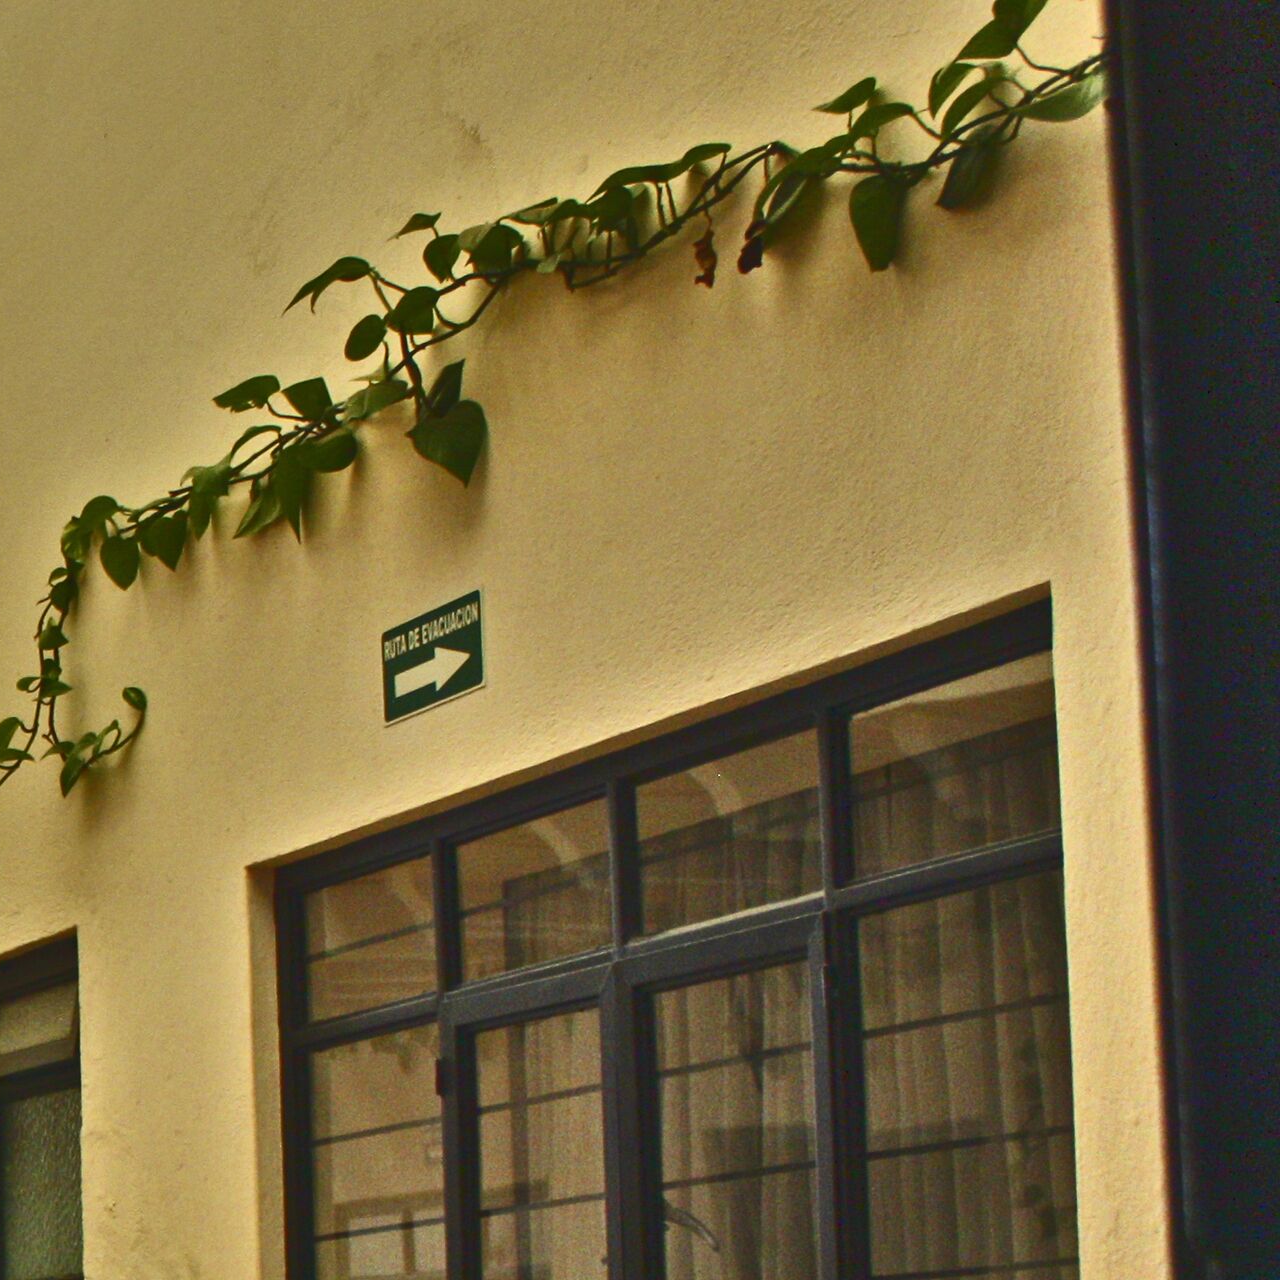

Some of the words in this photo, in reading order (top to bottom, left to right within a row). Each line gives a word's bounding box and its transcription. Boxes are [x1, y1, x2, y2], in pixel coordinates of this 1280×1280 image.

[384, 635, 407, 662] RUTA
[408, 627, 420, 651] DE
[421, 601, 479, 644] EVACUACION
